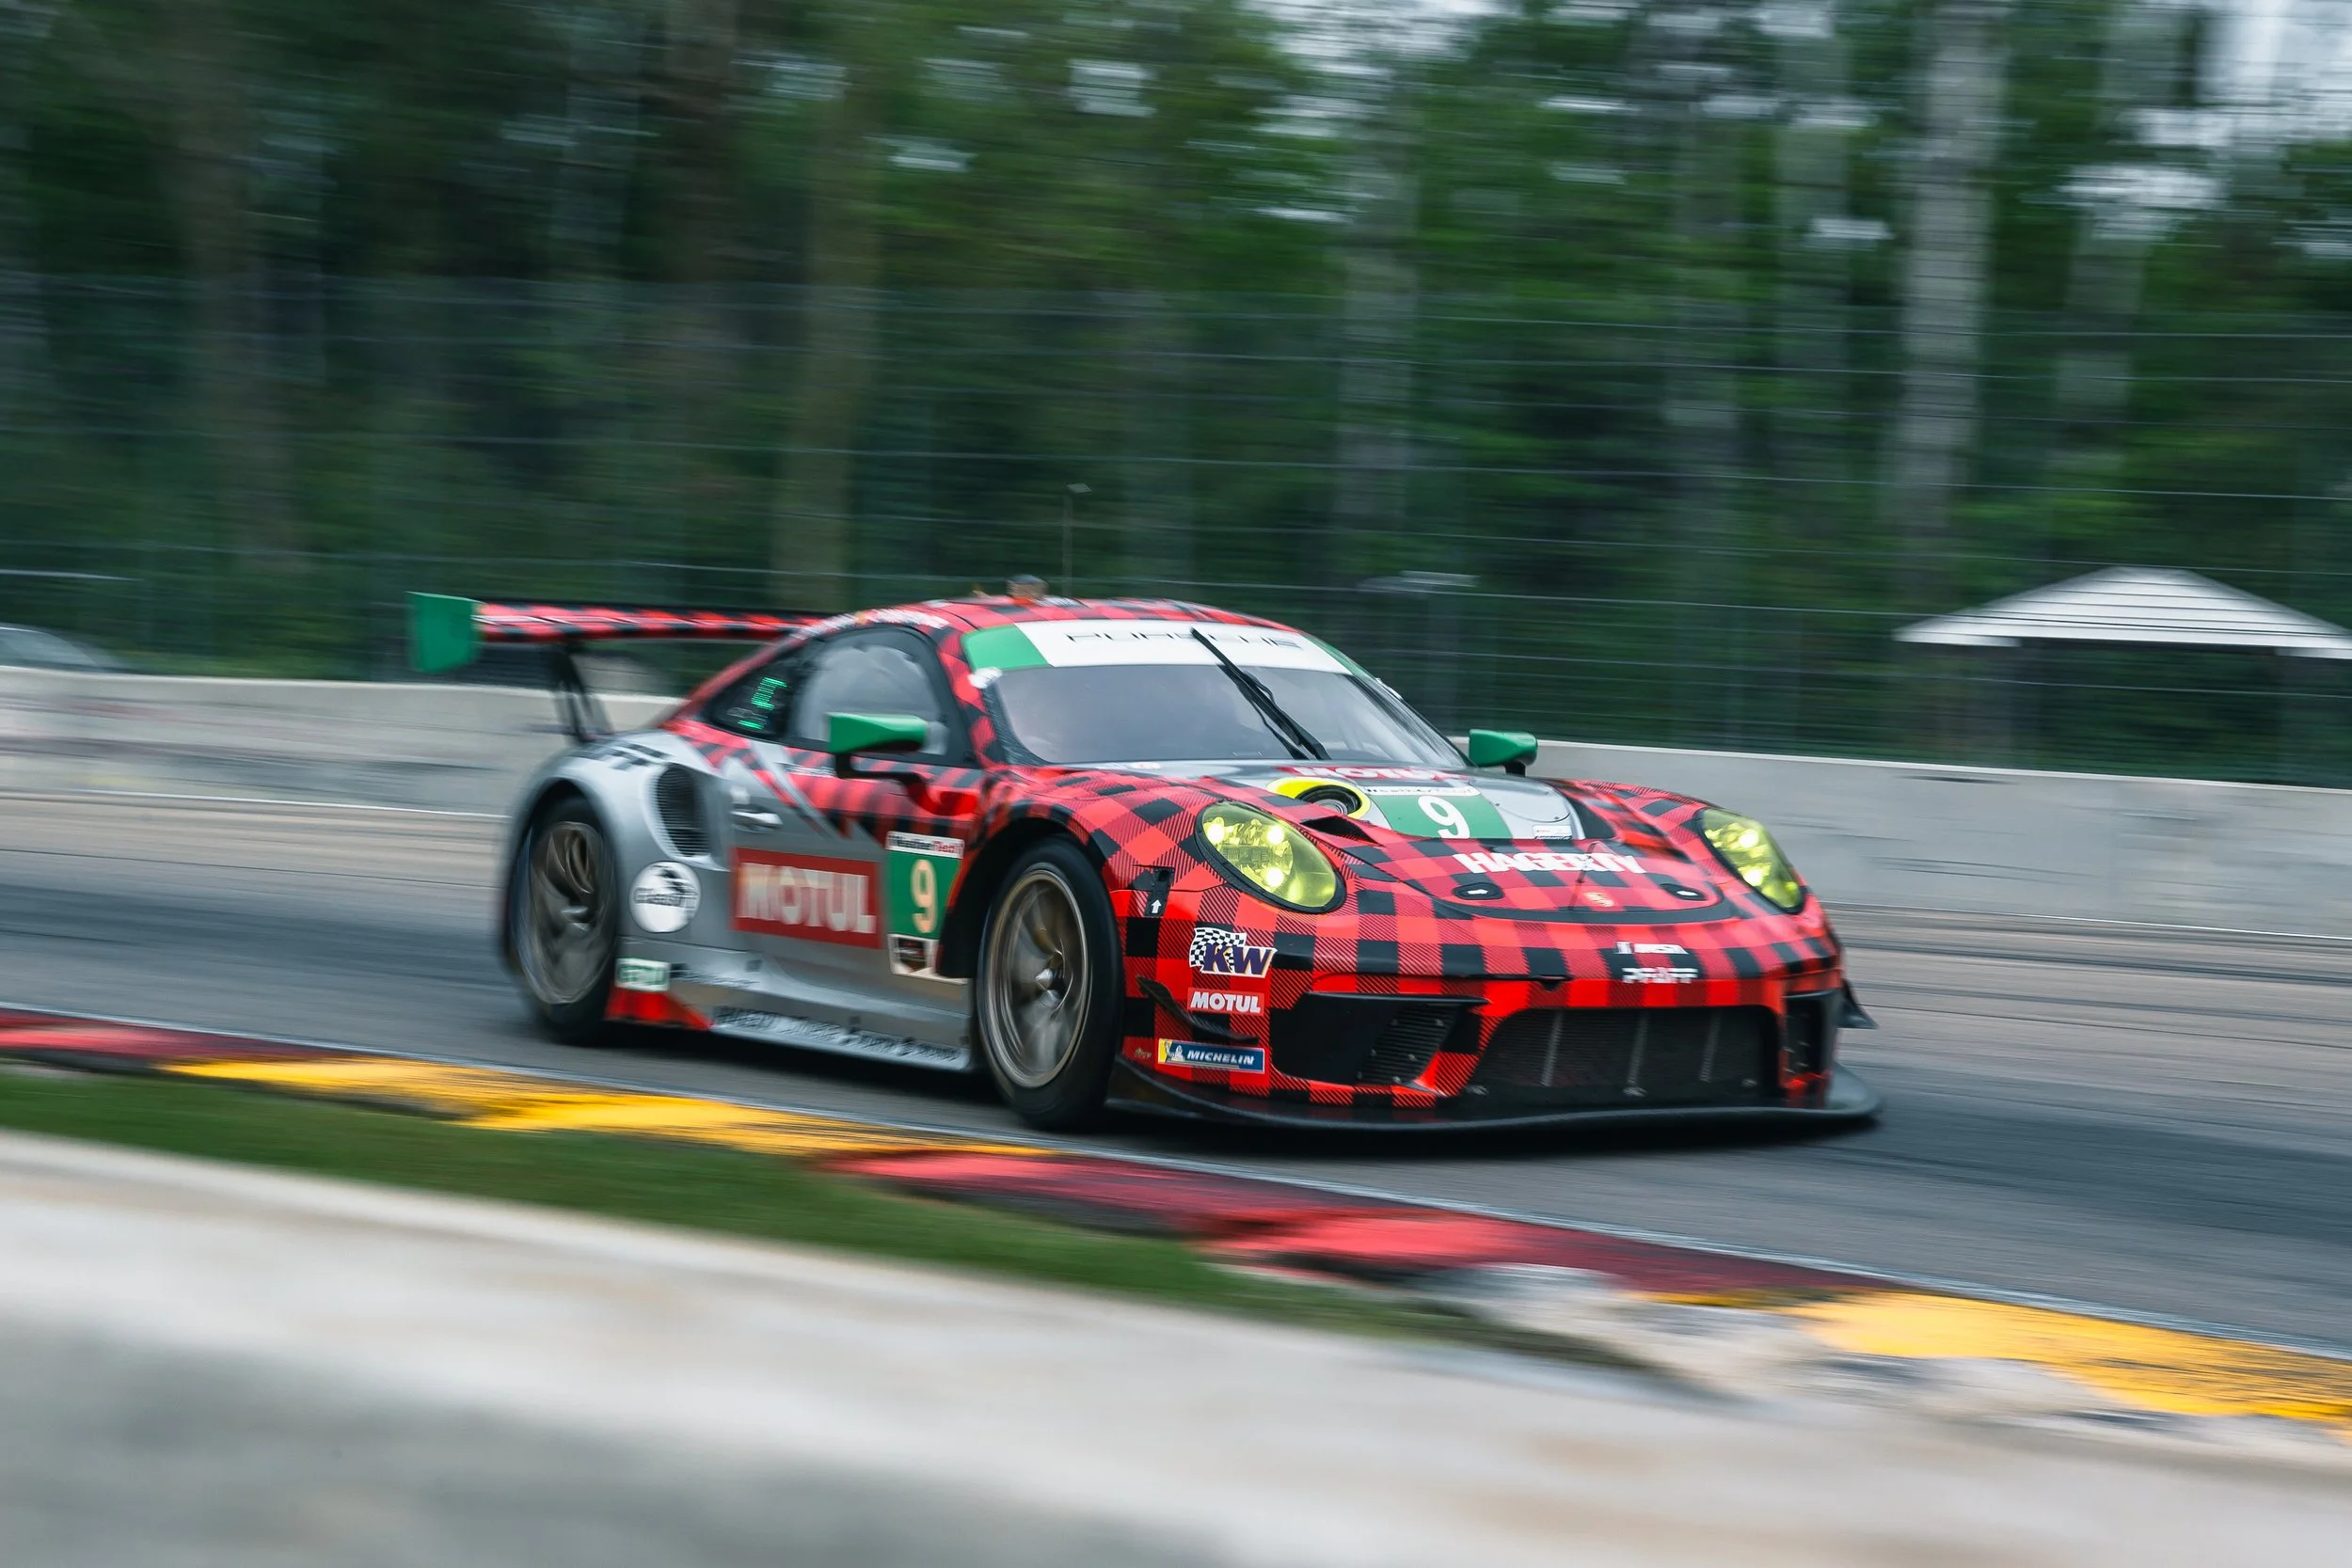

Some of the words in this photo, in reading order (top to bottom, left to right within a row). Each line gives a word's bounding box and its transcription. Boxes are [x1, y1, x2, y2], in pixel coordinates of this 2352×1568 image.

[1418, 796, 1470, 839] 9
[737, 862, 877, 934] MOTUL
[910, 859, 938, 934] 9
[1201, 942, 1271, 976] KW
[1189, 990, 1262, 1014] MOTUL
[1186, 1049, 1255, 1065] MICHELIN
